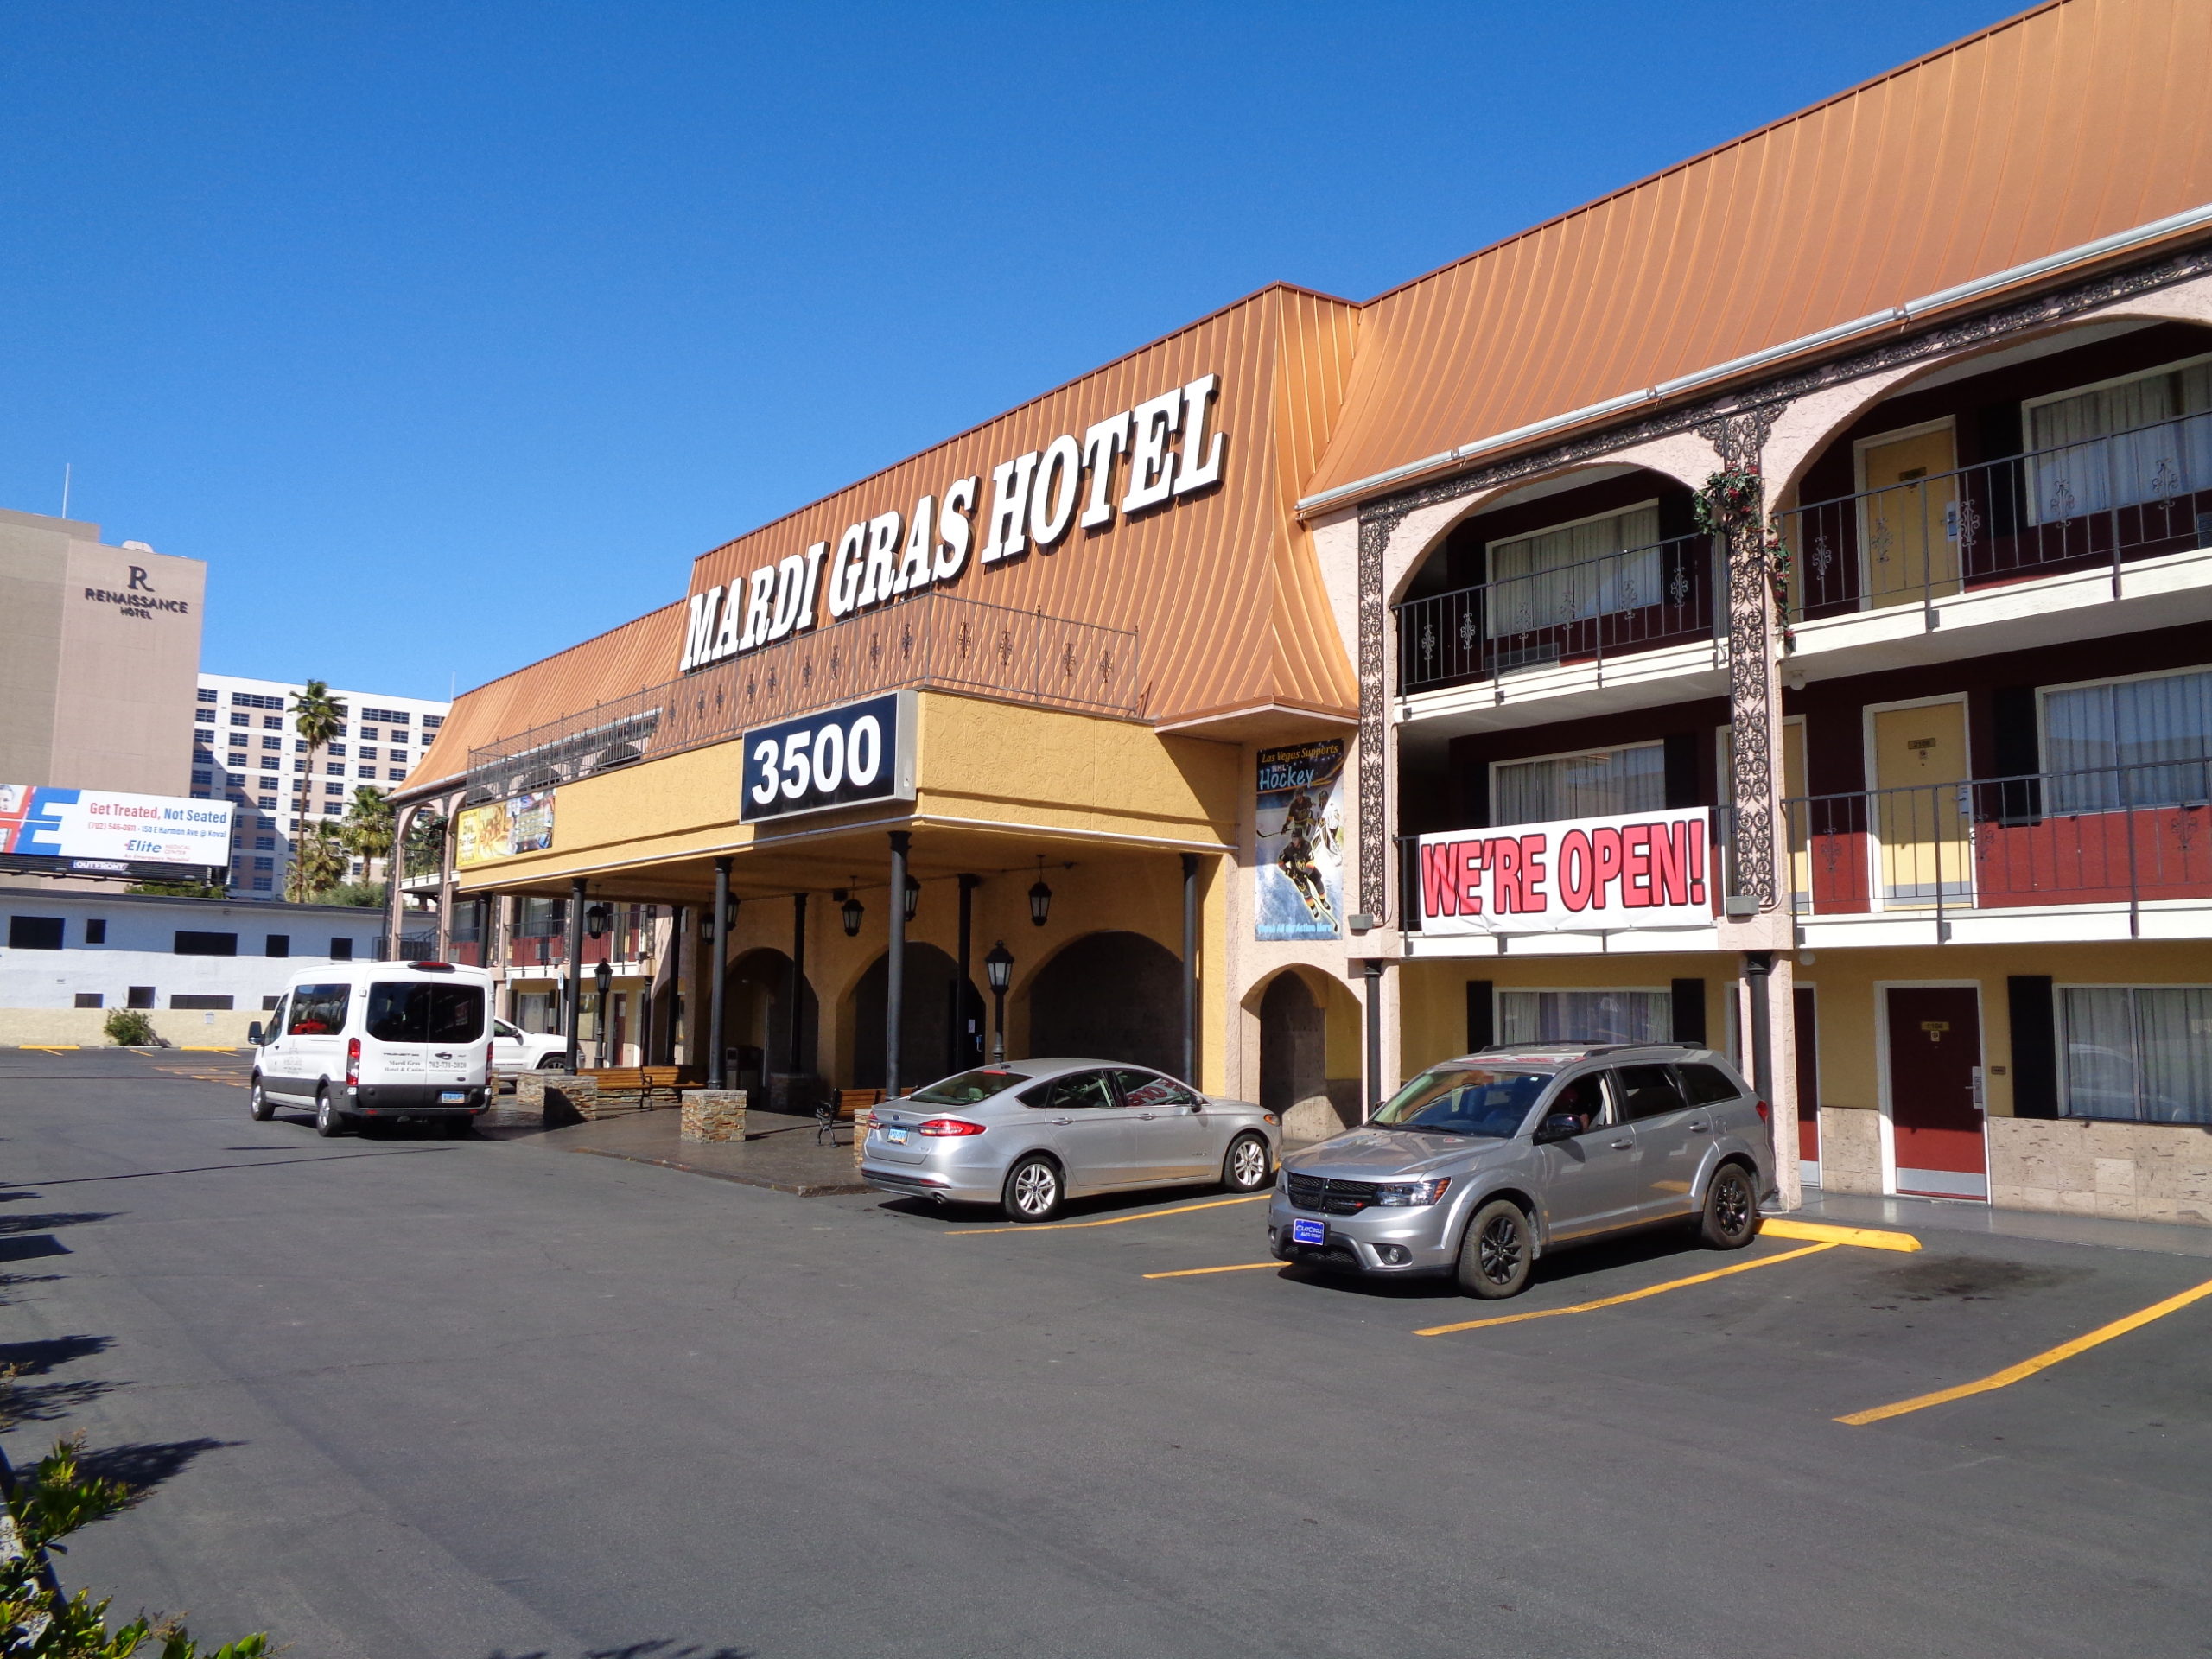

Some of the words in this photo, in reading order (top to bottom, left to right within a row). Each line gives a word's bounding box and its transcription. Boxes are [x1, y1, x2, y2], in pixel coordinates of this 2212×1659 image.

[679, 541, 828, 671] MARDI
[828, 475, 981, 619] GRAS
[981, 373, 1226, 564] HOTEL
[127, 565, 156, 592] R
[85, 588, 188, 614] RENAISSANCE
[120, 607, 152, 620] HOTEL
[751, 714, 882, 805] 3500
[1262, 753, 1275, 763] Las
[1277, 751, 1300, 762] Vegas
[1301, 745, 1339, 759] Supports
[1260, 766, 1314, 790] Hockey
[90, 802, 111, 816] Get
[113, 804, 161, 820] Treated,
[164, 808, 183, 821] Not
[186, 810, 226, 823] Seated
[126, 839, 162, 853] Elite
[75, 861, 127, 870] OUTFRONT
[1421, 833, 1547, 918] WE'RE
[1558, 818, 1706, 913] OPEN!
